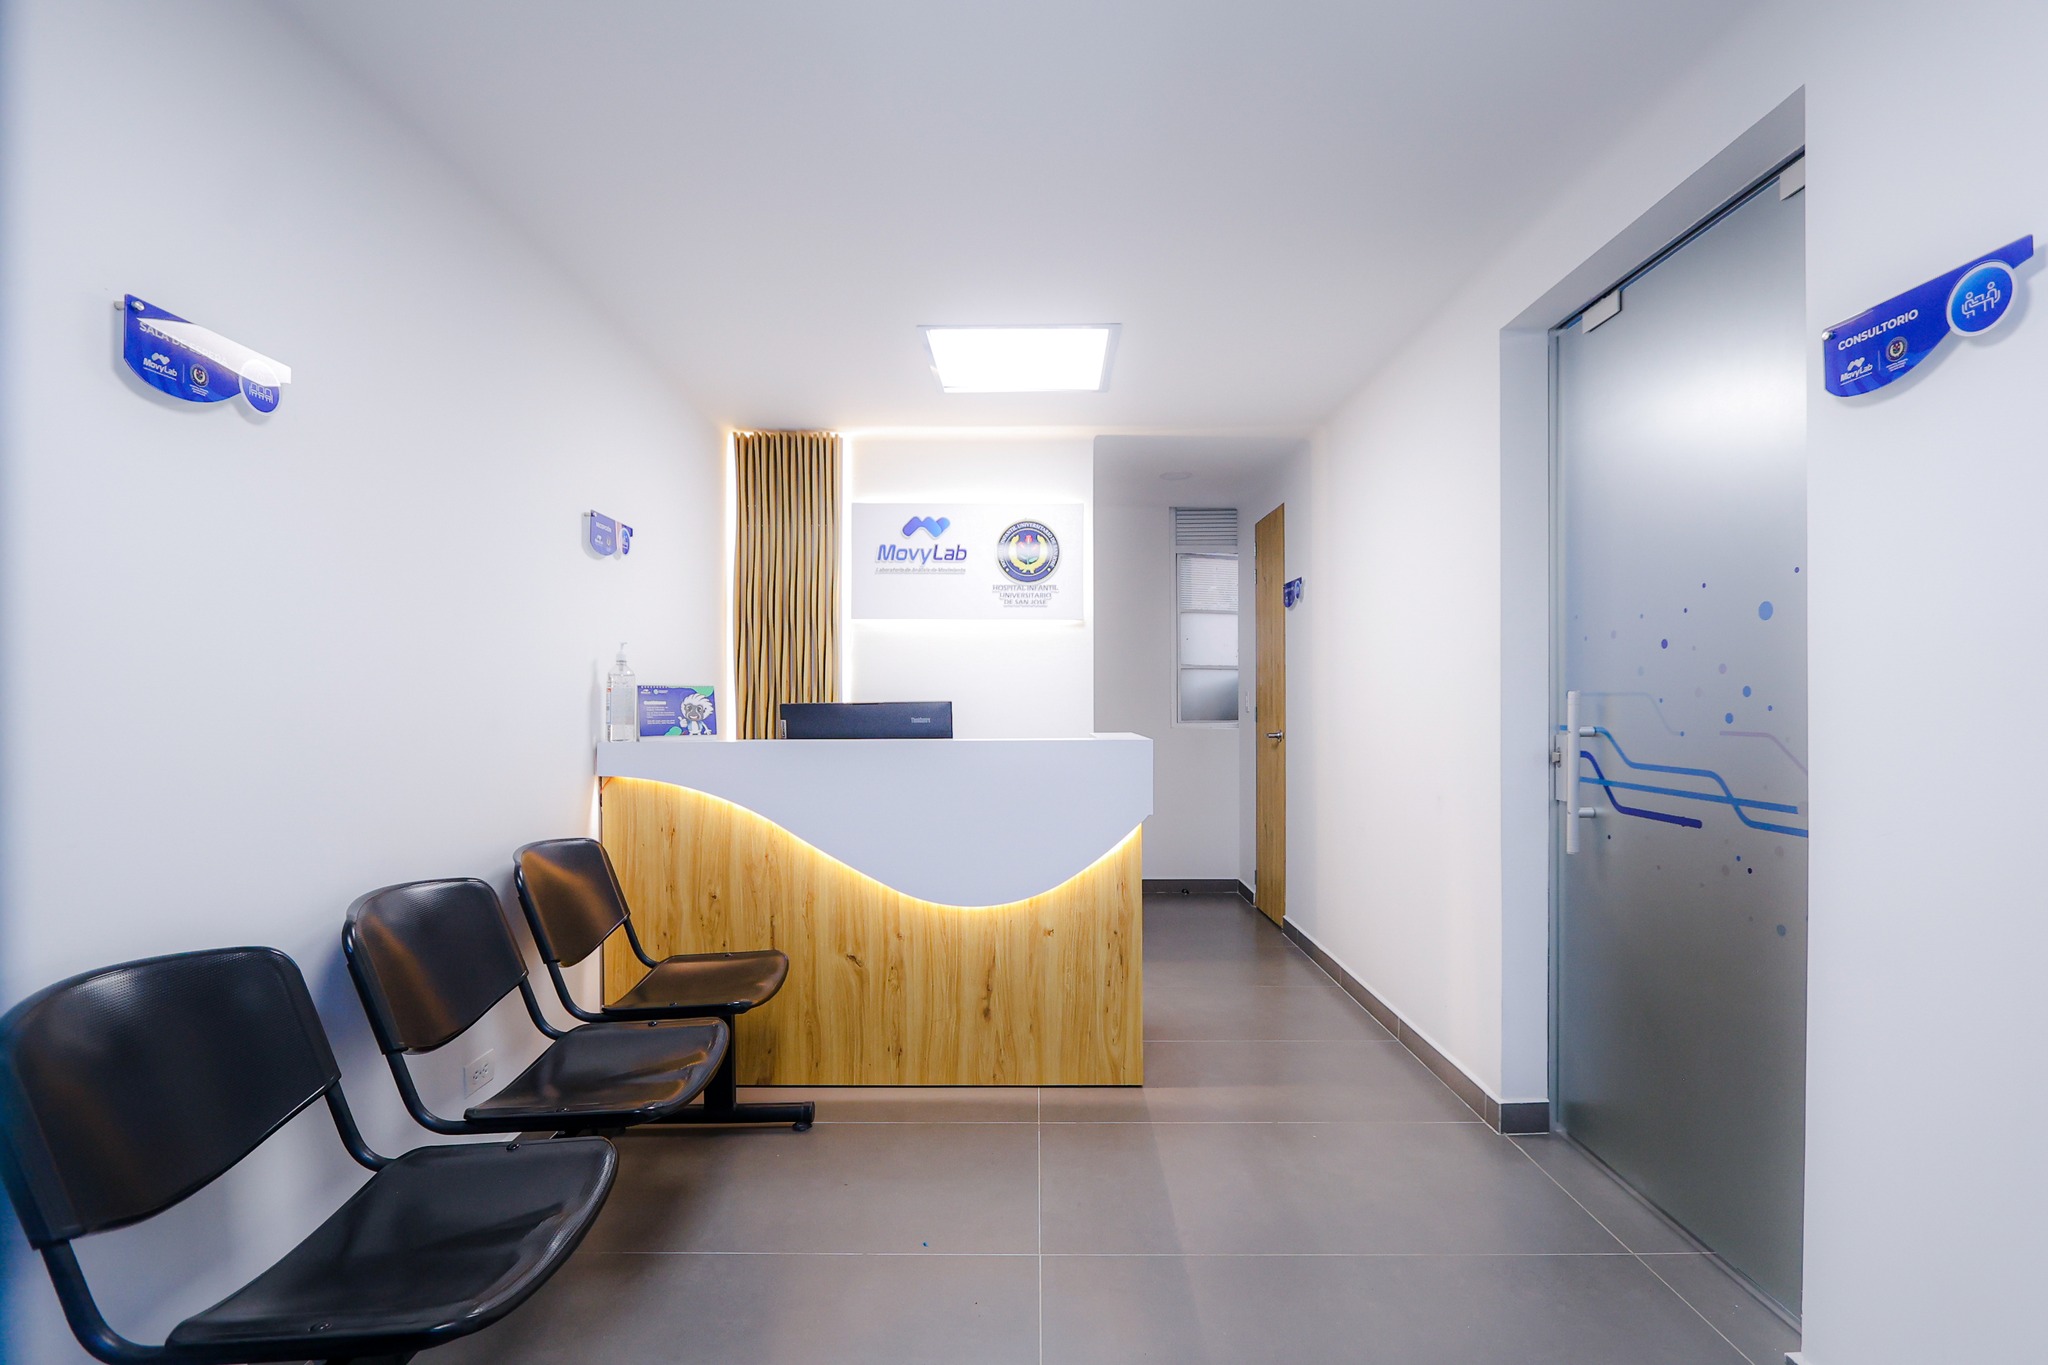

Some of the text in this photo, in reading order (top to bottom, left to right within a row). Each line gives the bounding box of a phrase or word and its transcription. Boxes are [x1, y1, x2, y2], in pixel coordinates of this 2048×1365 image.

[139, 322, 170, 342] SALA
[1838, 309, 1919, 351] CONSULTORIO
[143, 357, 177, 376] MovyLab
[1840, 363, 1873, 382] MovyLab
[877, 544, 968, 565] MovyLab
